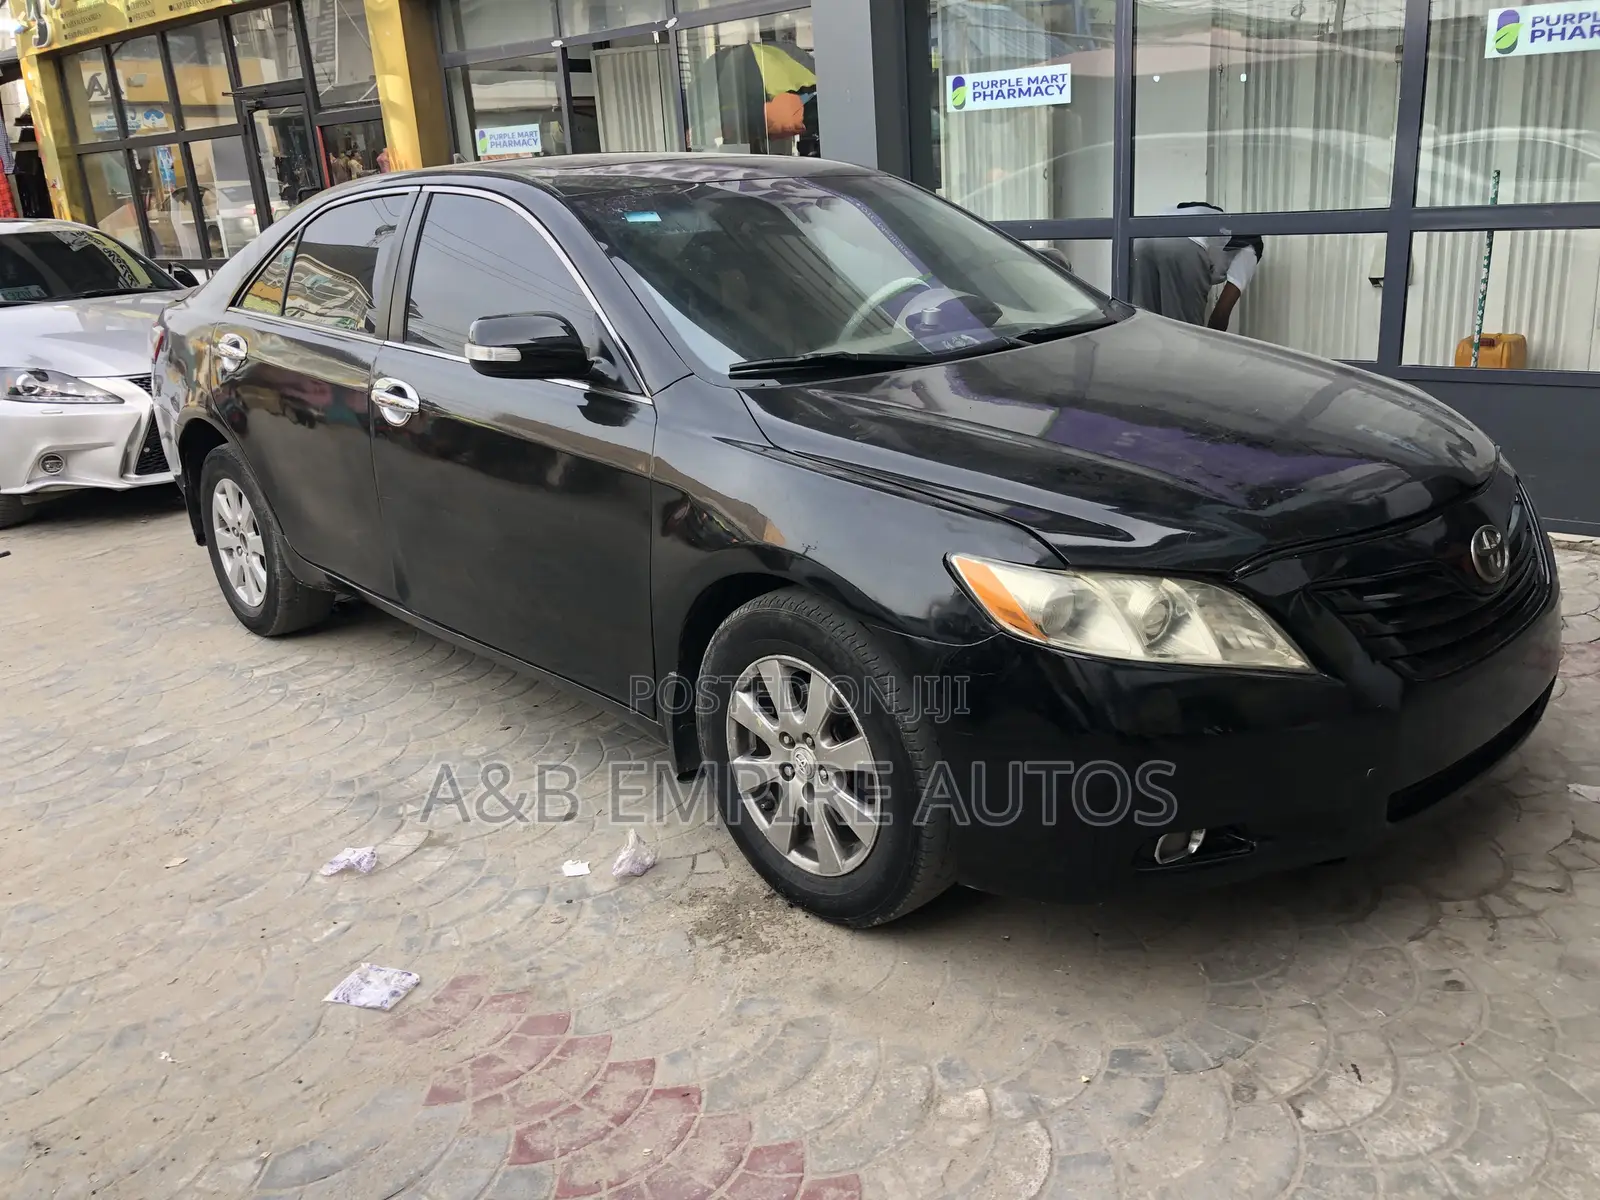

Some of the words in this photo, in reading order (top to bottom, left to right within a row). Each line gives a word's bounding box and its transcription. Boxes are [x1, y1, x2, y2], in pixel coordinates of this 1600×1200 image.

[973, 77, 1023, 90] PURPLE
[1028, 73, 1068, 86] MART
[973, 84, 1067, 102] PHARMACY
[489, 132, 516, 141] PURPLE
[517, 130, 538, 139] MART
[490, 138, 539, 149] PHARMACY
